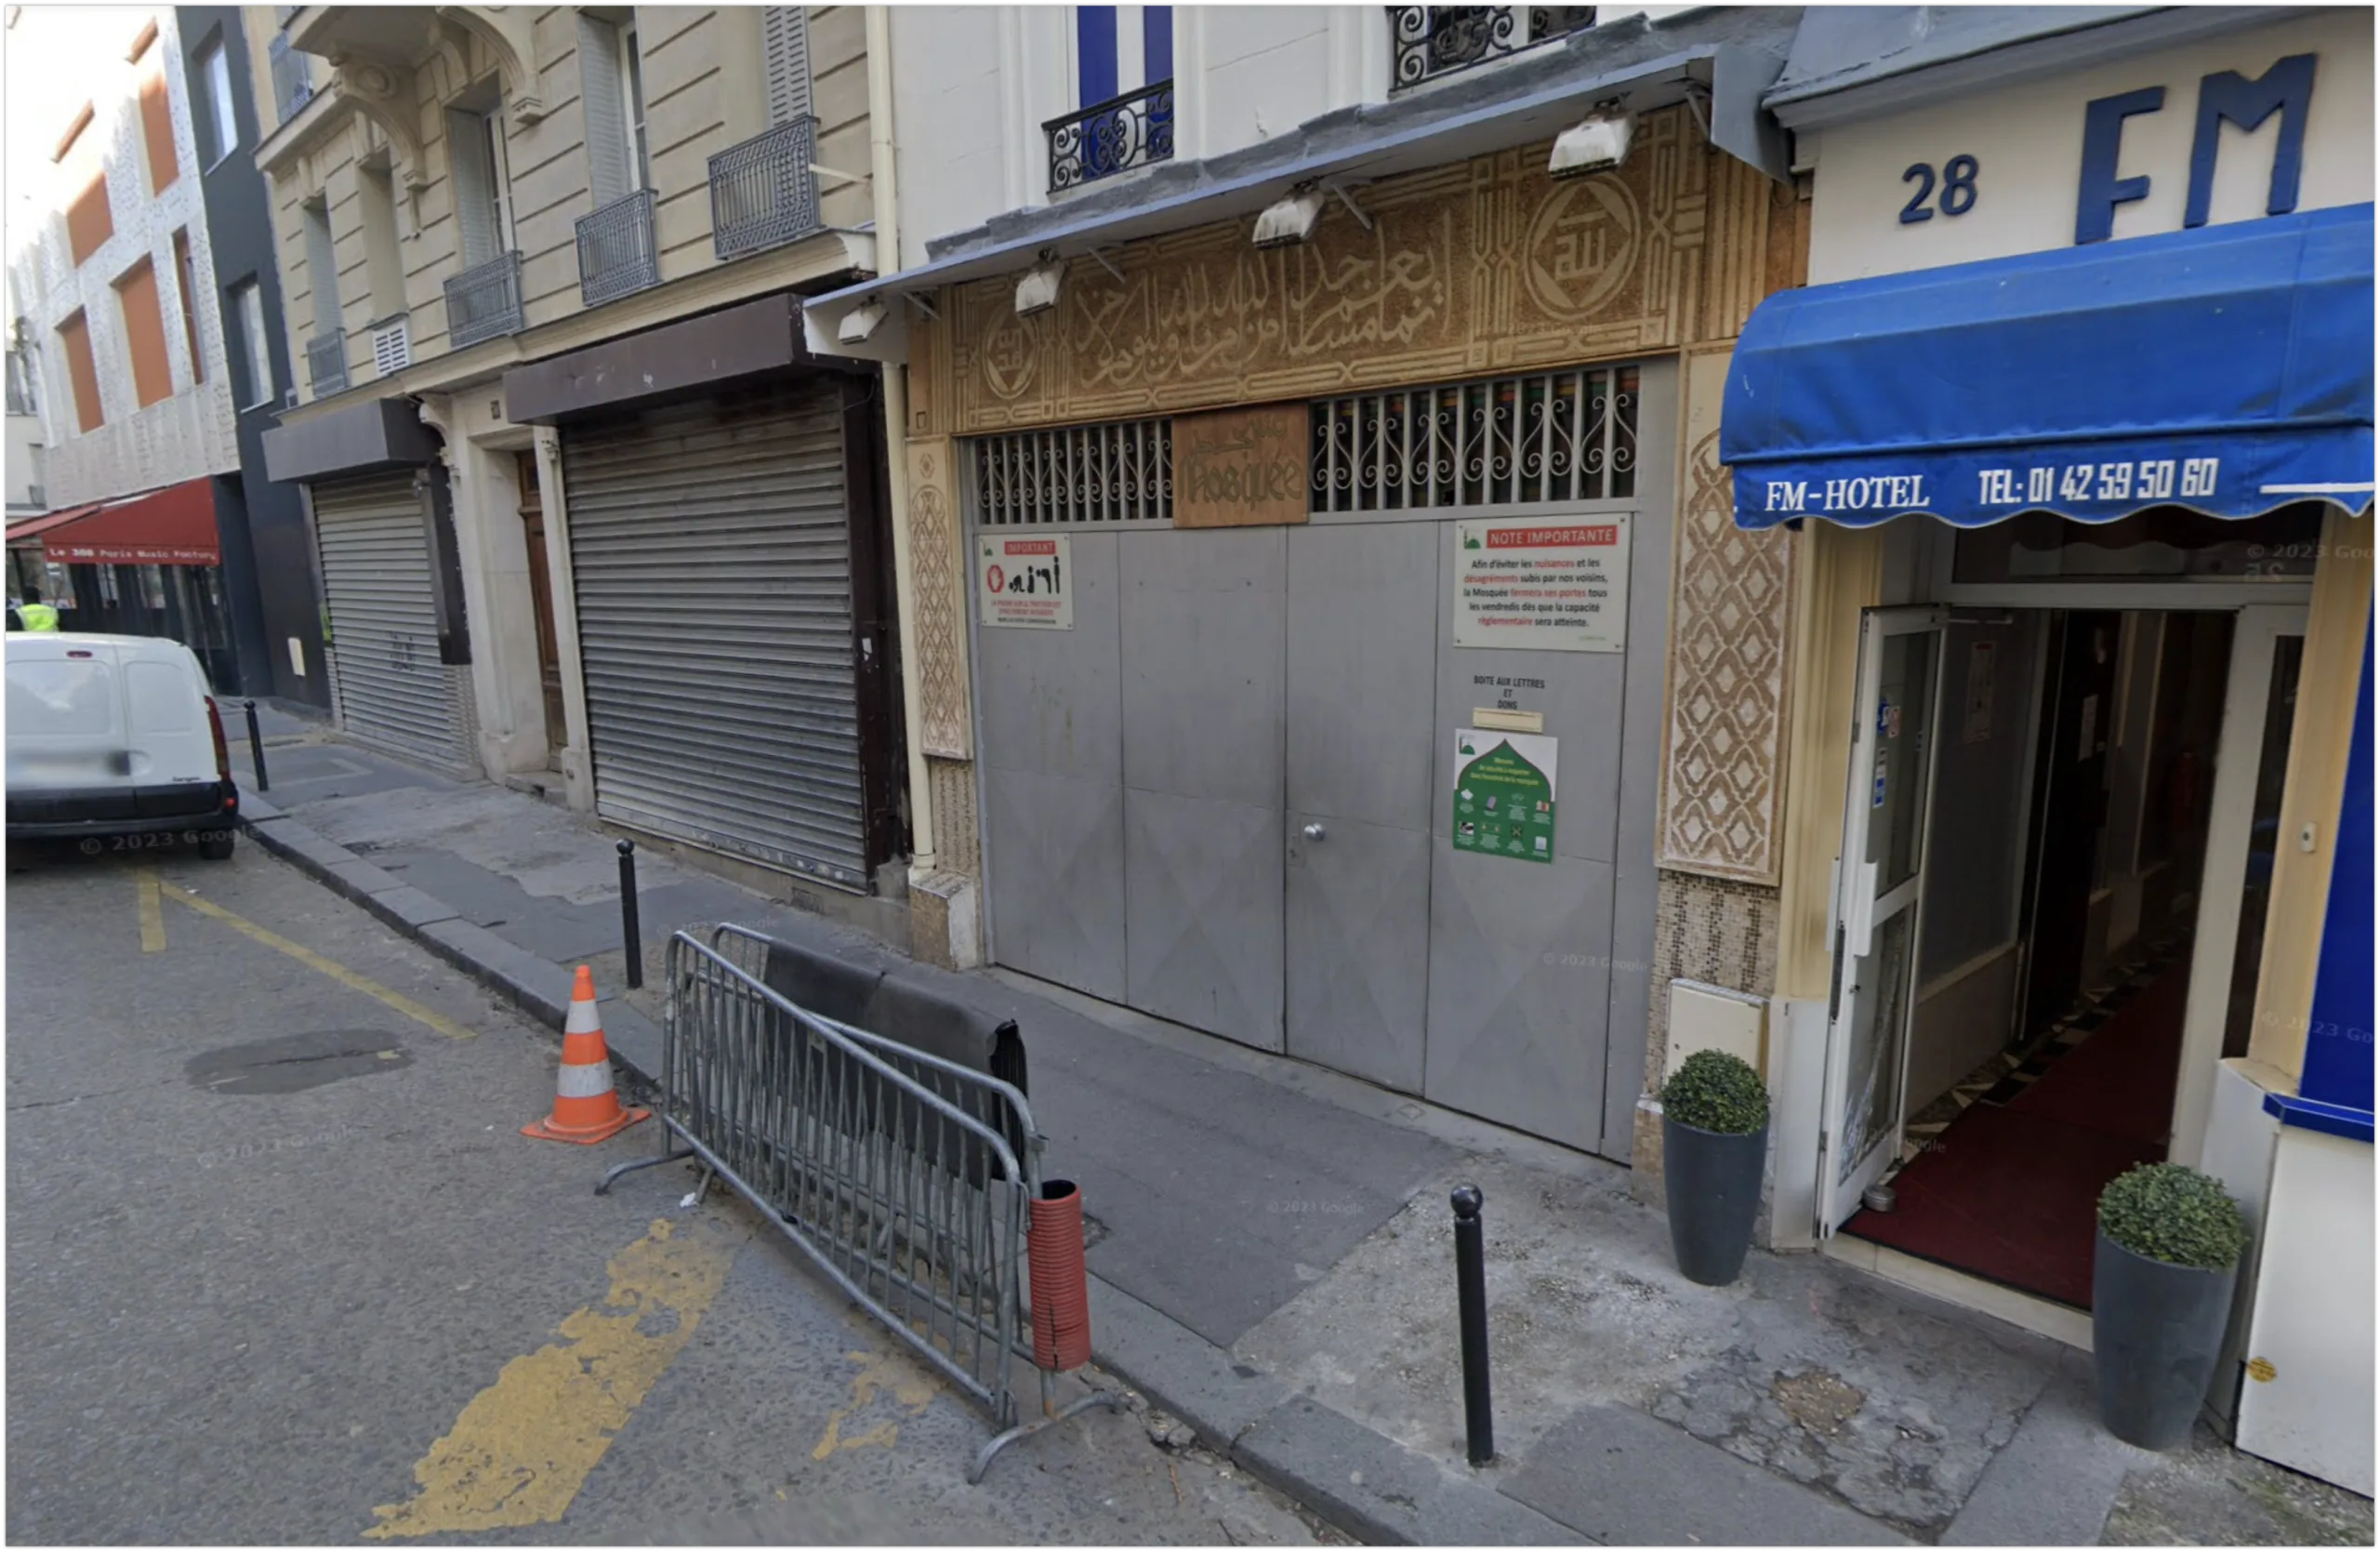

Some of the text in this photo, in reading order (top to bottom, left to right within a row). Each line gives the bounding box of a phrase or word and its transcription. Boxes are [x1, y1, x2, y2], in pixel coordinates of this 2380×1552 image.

[2074, 52, 2317, 245] FM
[1899, 153, 1978, 224] 28
[1765, 458, 2219, 511] FM-HOTEL TEL: 01 42 59 50 60
[1490, 528, 1613, 545] NOTE IMPORTANTE
[1472, 558, 1600, 569] Afin d'éviter les nuisances et les
[1520, 574, 1540, 583] subis
[1542, 575, 1557, 585] par
[1559, 575, 1573, 583] nos
[1576, 574, 1608, 584] voisins,
[1463, 589, 1471, 597] la
[1473, 588, 1508, 599] Mosquée
[1544, 590, 1557, 598] ses
[1559, 589, 1586, 599] portes
[1588, 589, 1607, 598] tous
[1469, 603, 1480, 611] les
[1482, 603, 1520, 612] vendredis
[1538, 604, 1554, 614] que
[1555, 603, 1563, 612] la
[1565, 604, 1600, 615] capacité
[1535, 617, 1552, 627] sera
[1474, 675, 1545, 689] BOITE AUX LETTRES
[1503, 688, 1514, 697] ET
[1497, 699, 1518, 710] DONS
